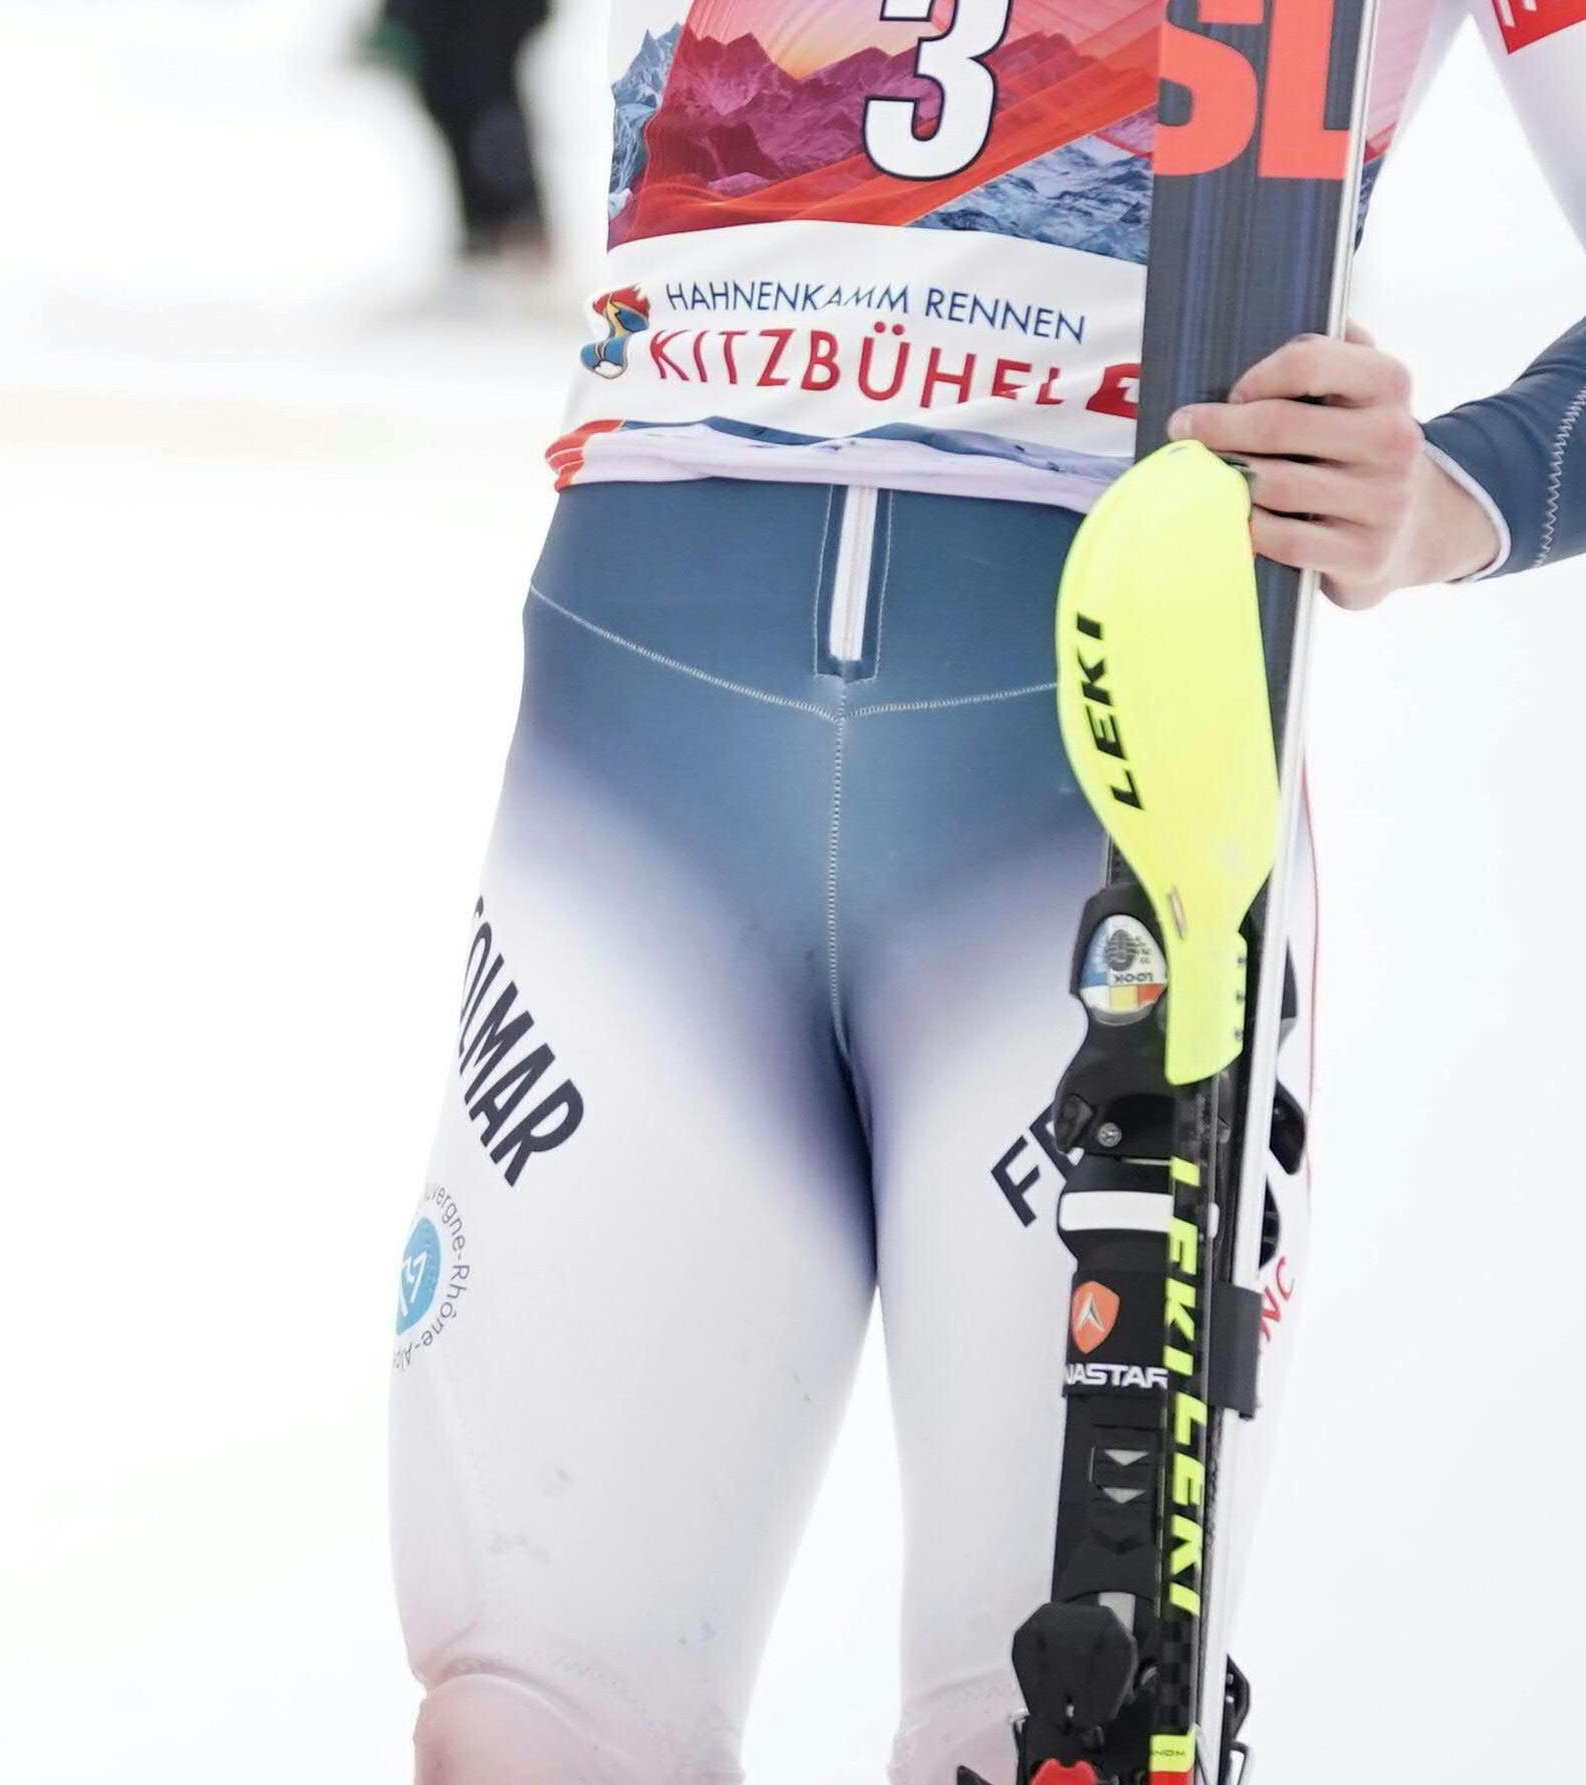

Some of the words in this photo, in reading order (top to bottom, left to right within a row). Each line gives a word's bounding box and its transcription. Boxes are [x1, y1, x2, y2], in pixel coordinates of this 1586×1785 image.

[665, 280, 910, 314] HAHNENKAMM
[926, 288, 1086, 345] RENNEN
[649, 320, 1066, 410] KITZBÜHEL
[1076, 612, 1145, 812] LEKI
